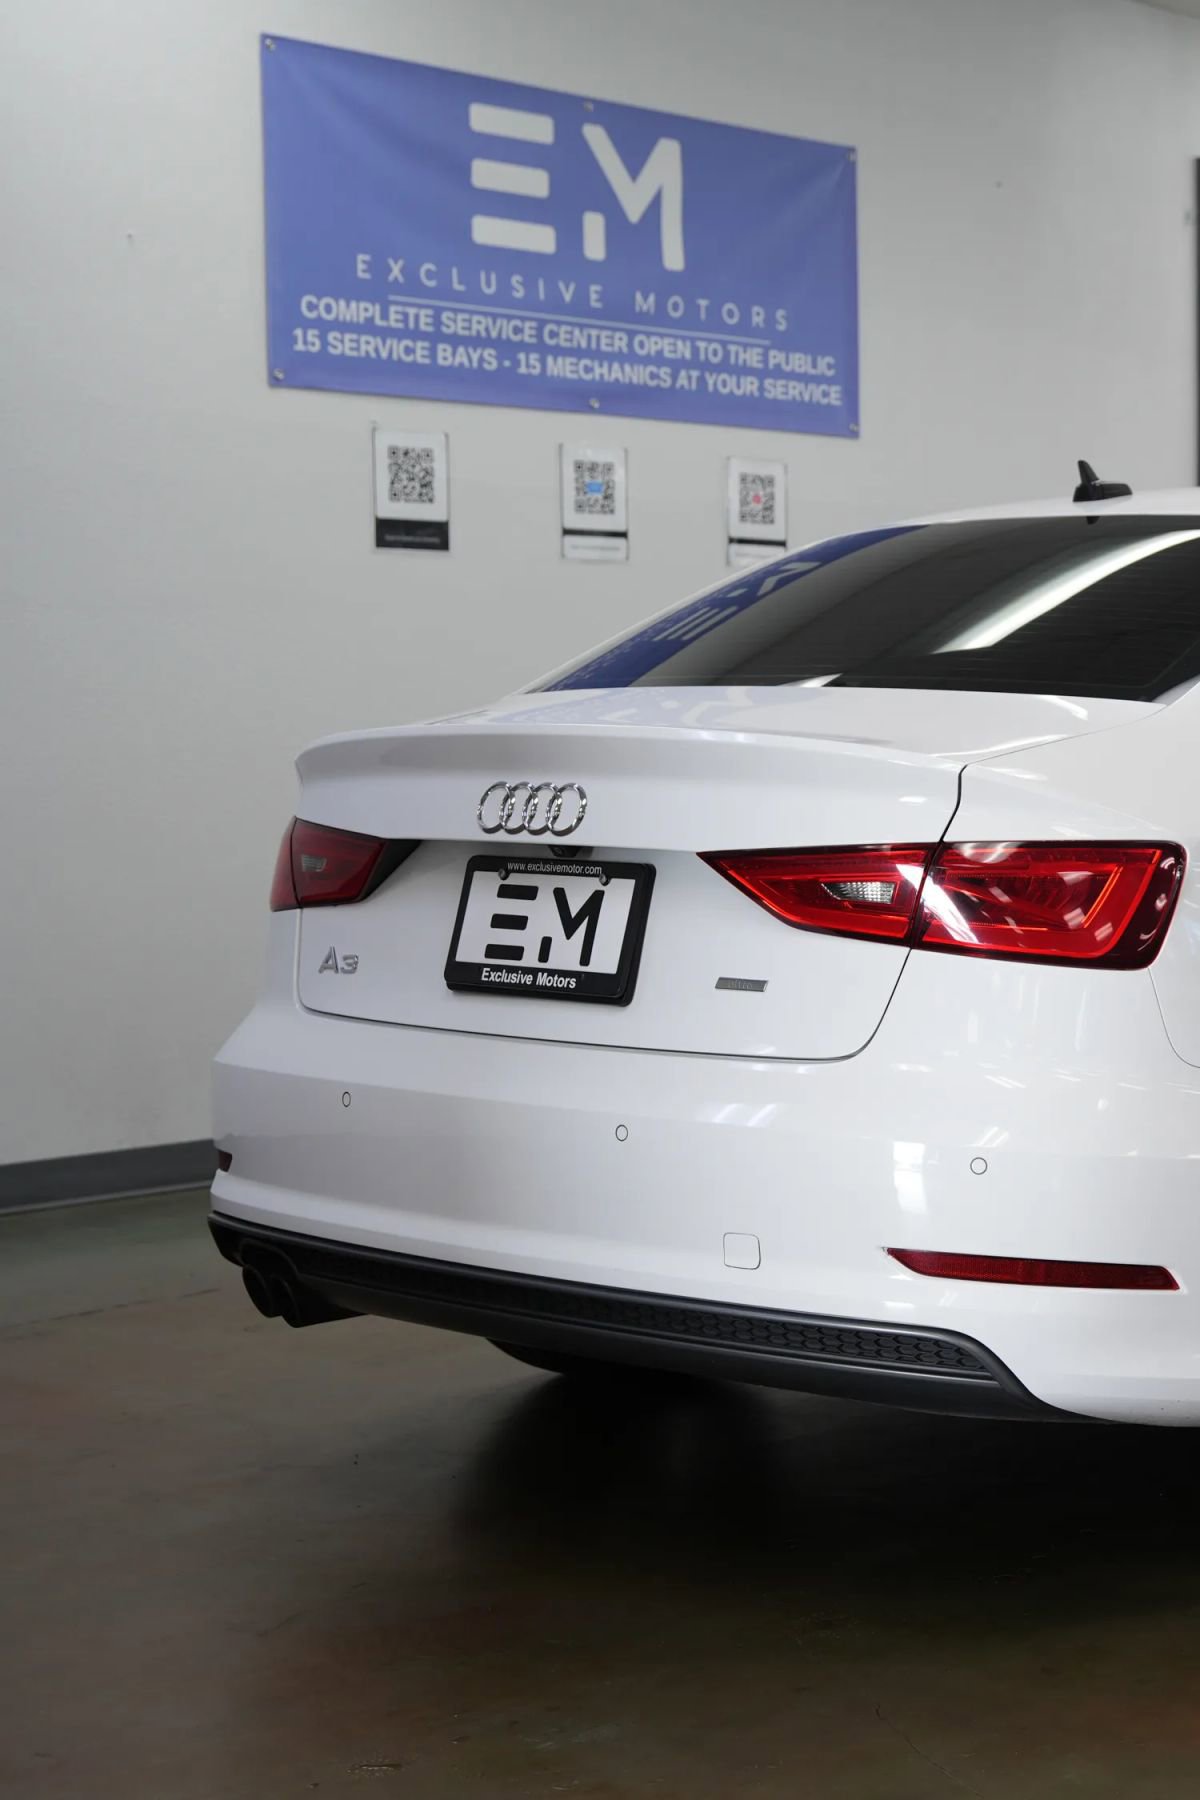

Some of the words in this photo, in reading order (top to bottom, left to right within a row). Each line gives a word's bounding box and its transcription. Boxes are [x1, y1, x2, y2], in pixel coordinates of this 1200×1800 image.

[469, 102, 685, 271] EM
[356, 254, 603, 309] EXCLUSIVE
[634, 291, 788, 332] MOTORS
[292, 328, 321, 353] 15
[327, 331, 431, 365] SERVICE
[437, 344, 498, 372] BAYS
[516, 352, 541, 375] 15
[546, 355, 672, 389] MECHANICS
[676, 370, 701, 391] AT
[704, 371, 759, 397] YOUR
[764, 378, 843, 407] SERVICE
[301, 294, 435, 333] COMPLETE
[440, 311, 538, 344] SERVICE
[543, 323, 629, 353] CENTER
[633, 334, 692, 360] OPEN
[696, 341, 723, 364] TO
[727, 345, 764, 369] THE
[768, 350, 836, 377] PUBLIC
[507, 860, 602, 875] www.exclusivemotor.com
[318, 946, 359, 974] A3
[484, 883, 605, 967] EM
[481, 967, 533, 985] Exclusive
[536, 971, 577, 989] Motors
